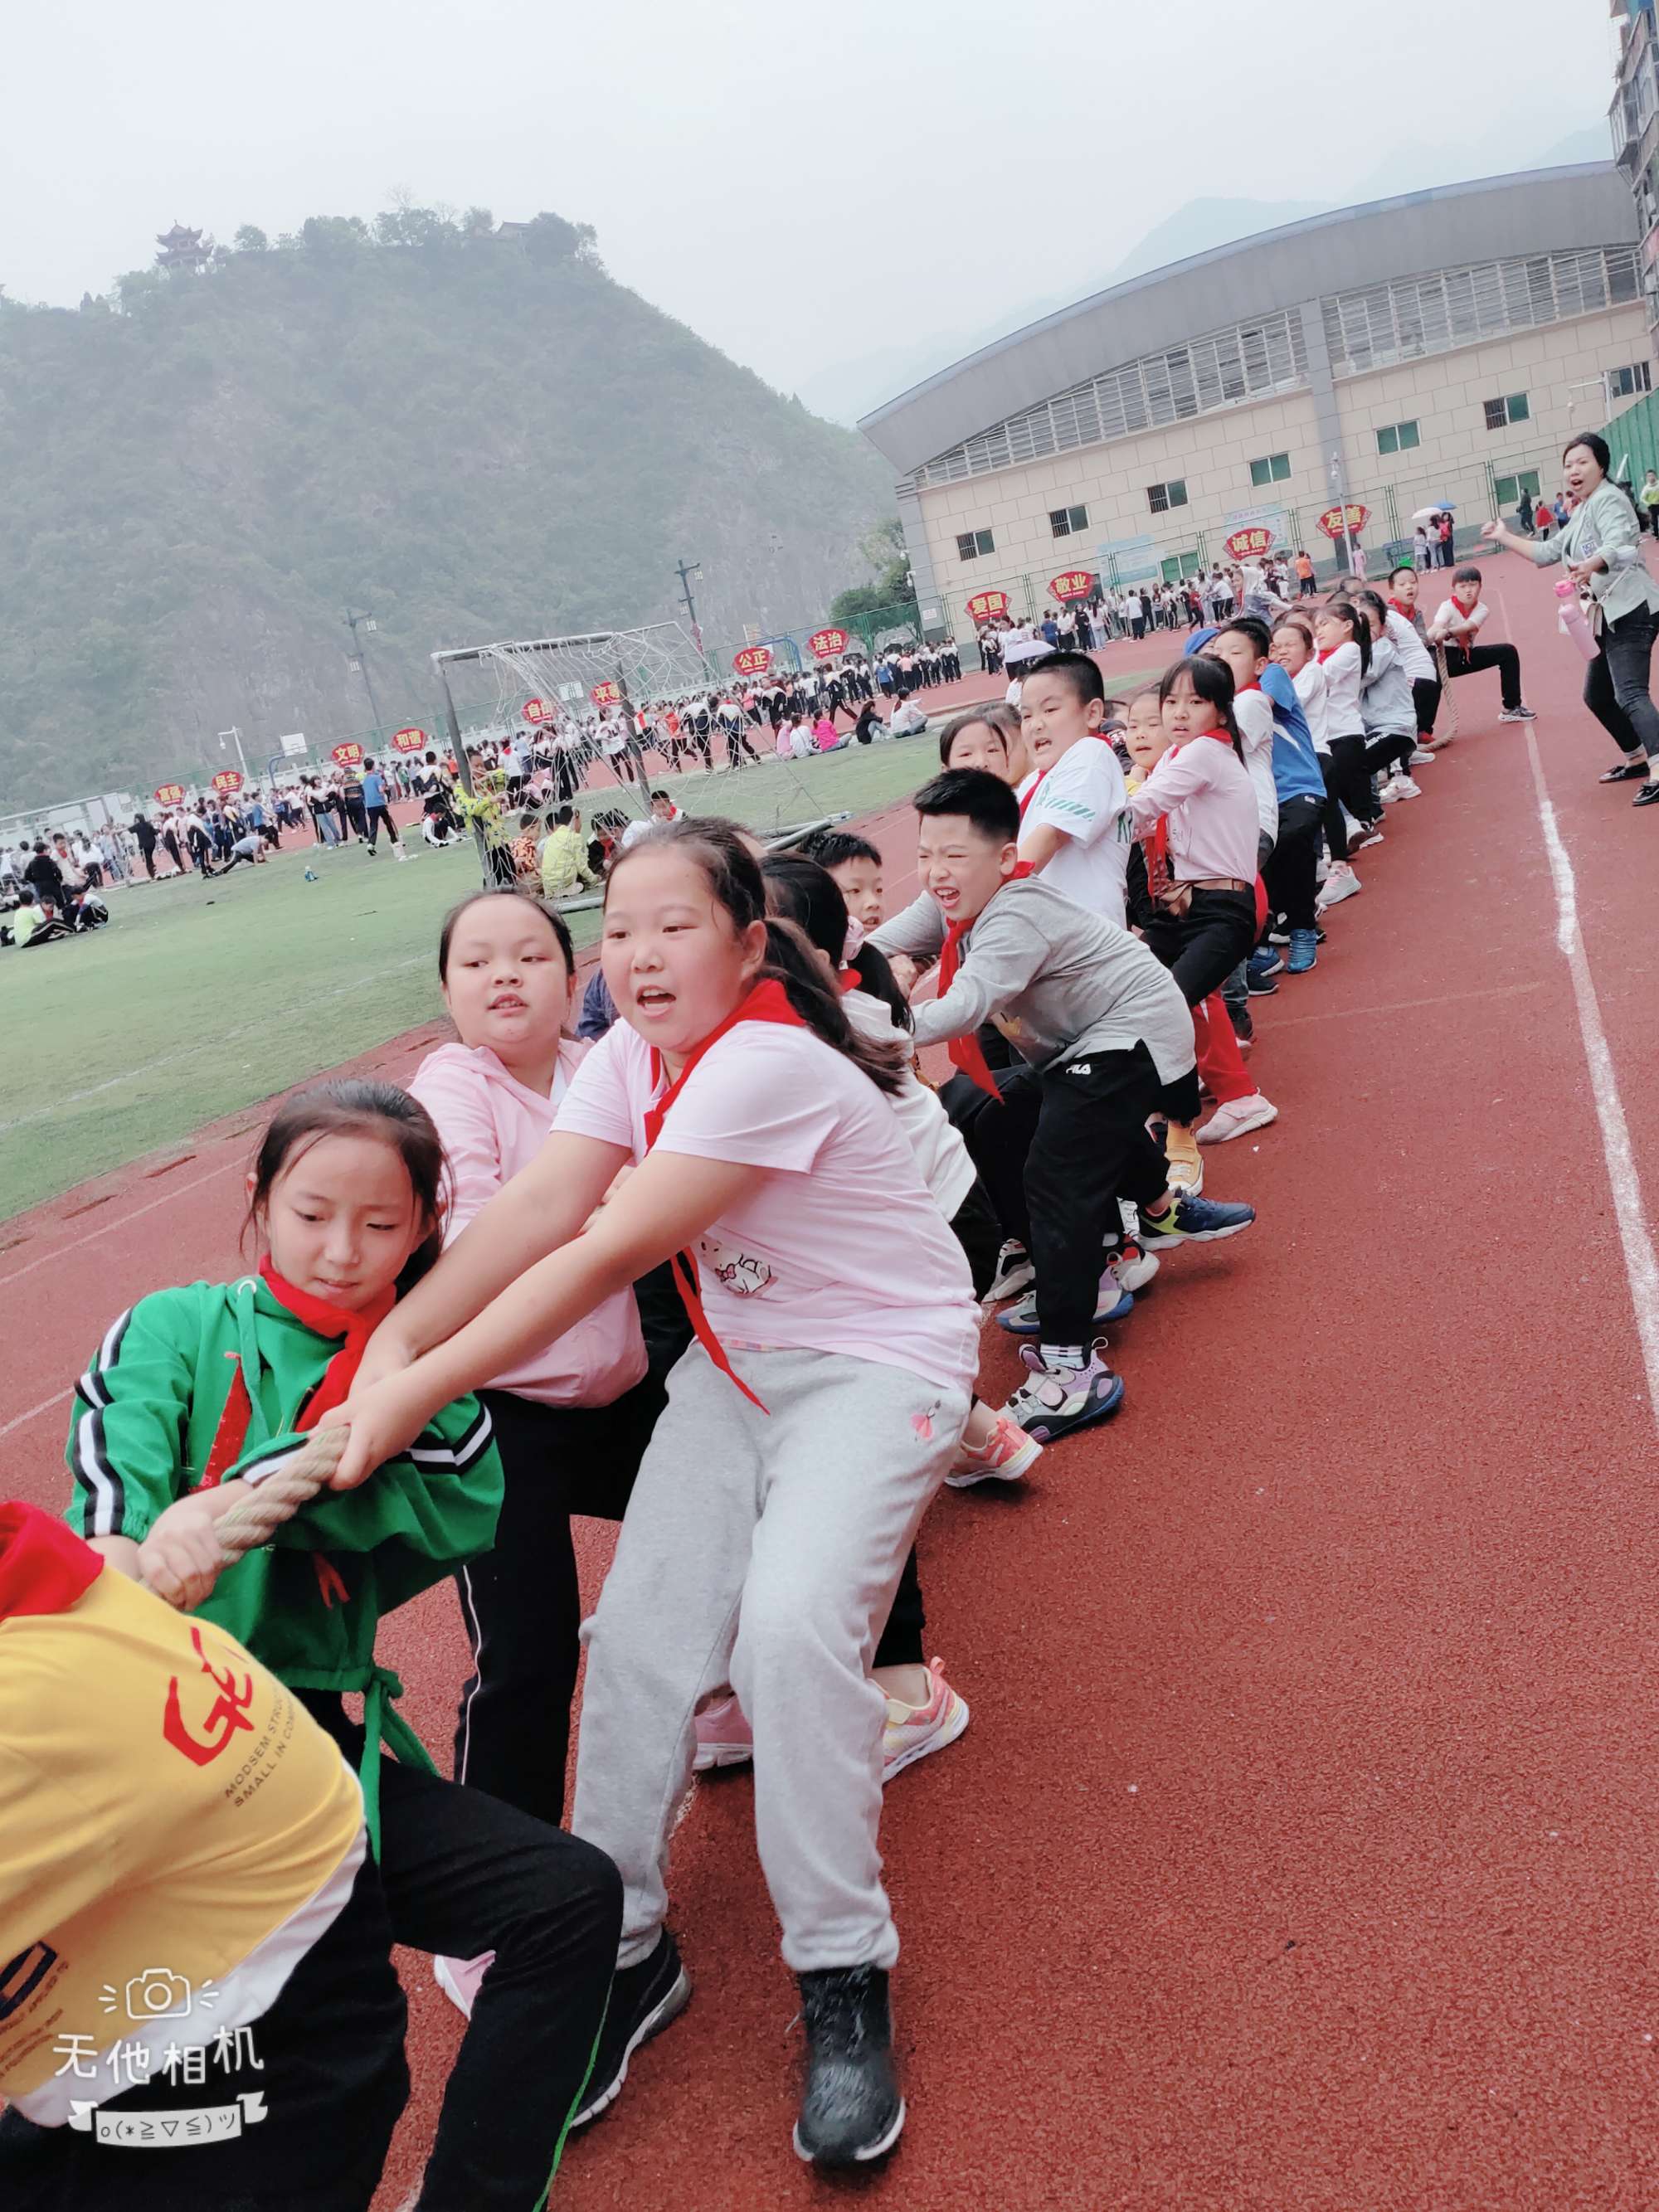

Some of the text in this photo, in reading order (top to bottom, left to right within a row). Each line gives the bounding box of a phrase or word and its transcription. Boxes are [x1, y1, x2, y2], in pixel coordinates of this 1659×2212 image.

[1326, 506, 1361, 527] 友善
[1232, 531, 1267, 552] 诚信
[1055, 573, 1087, 594] 敬业
[972, 594, 1003, 614] 爱国
[814, 632, 843, 651] 法治
[739, 650, 767, 668] 公正
[397, 730, 421, 747] 和谐
[336, 745, 359, 761] 文明
[216, 773, 239, 789] 民主
[234, 1762, 276, 1807] SMALL
[275, 1741, 287, 1758] IN
